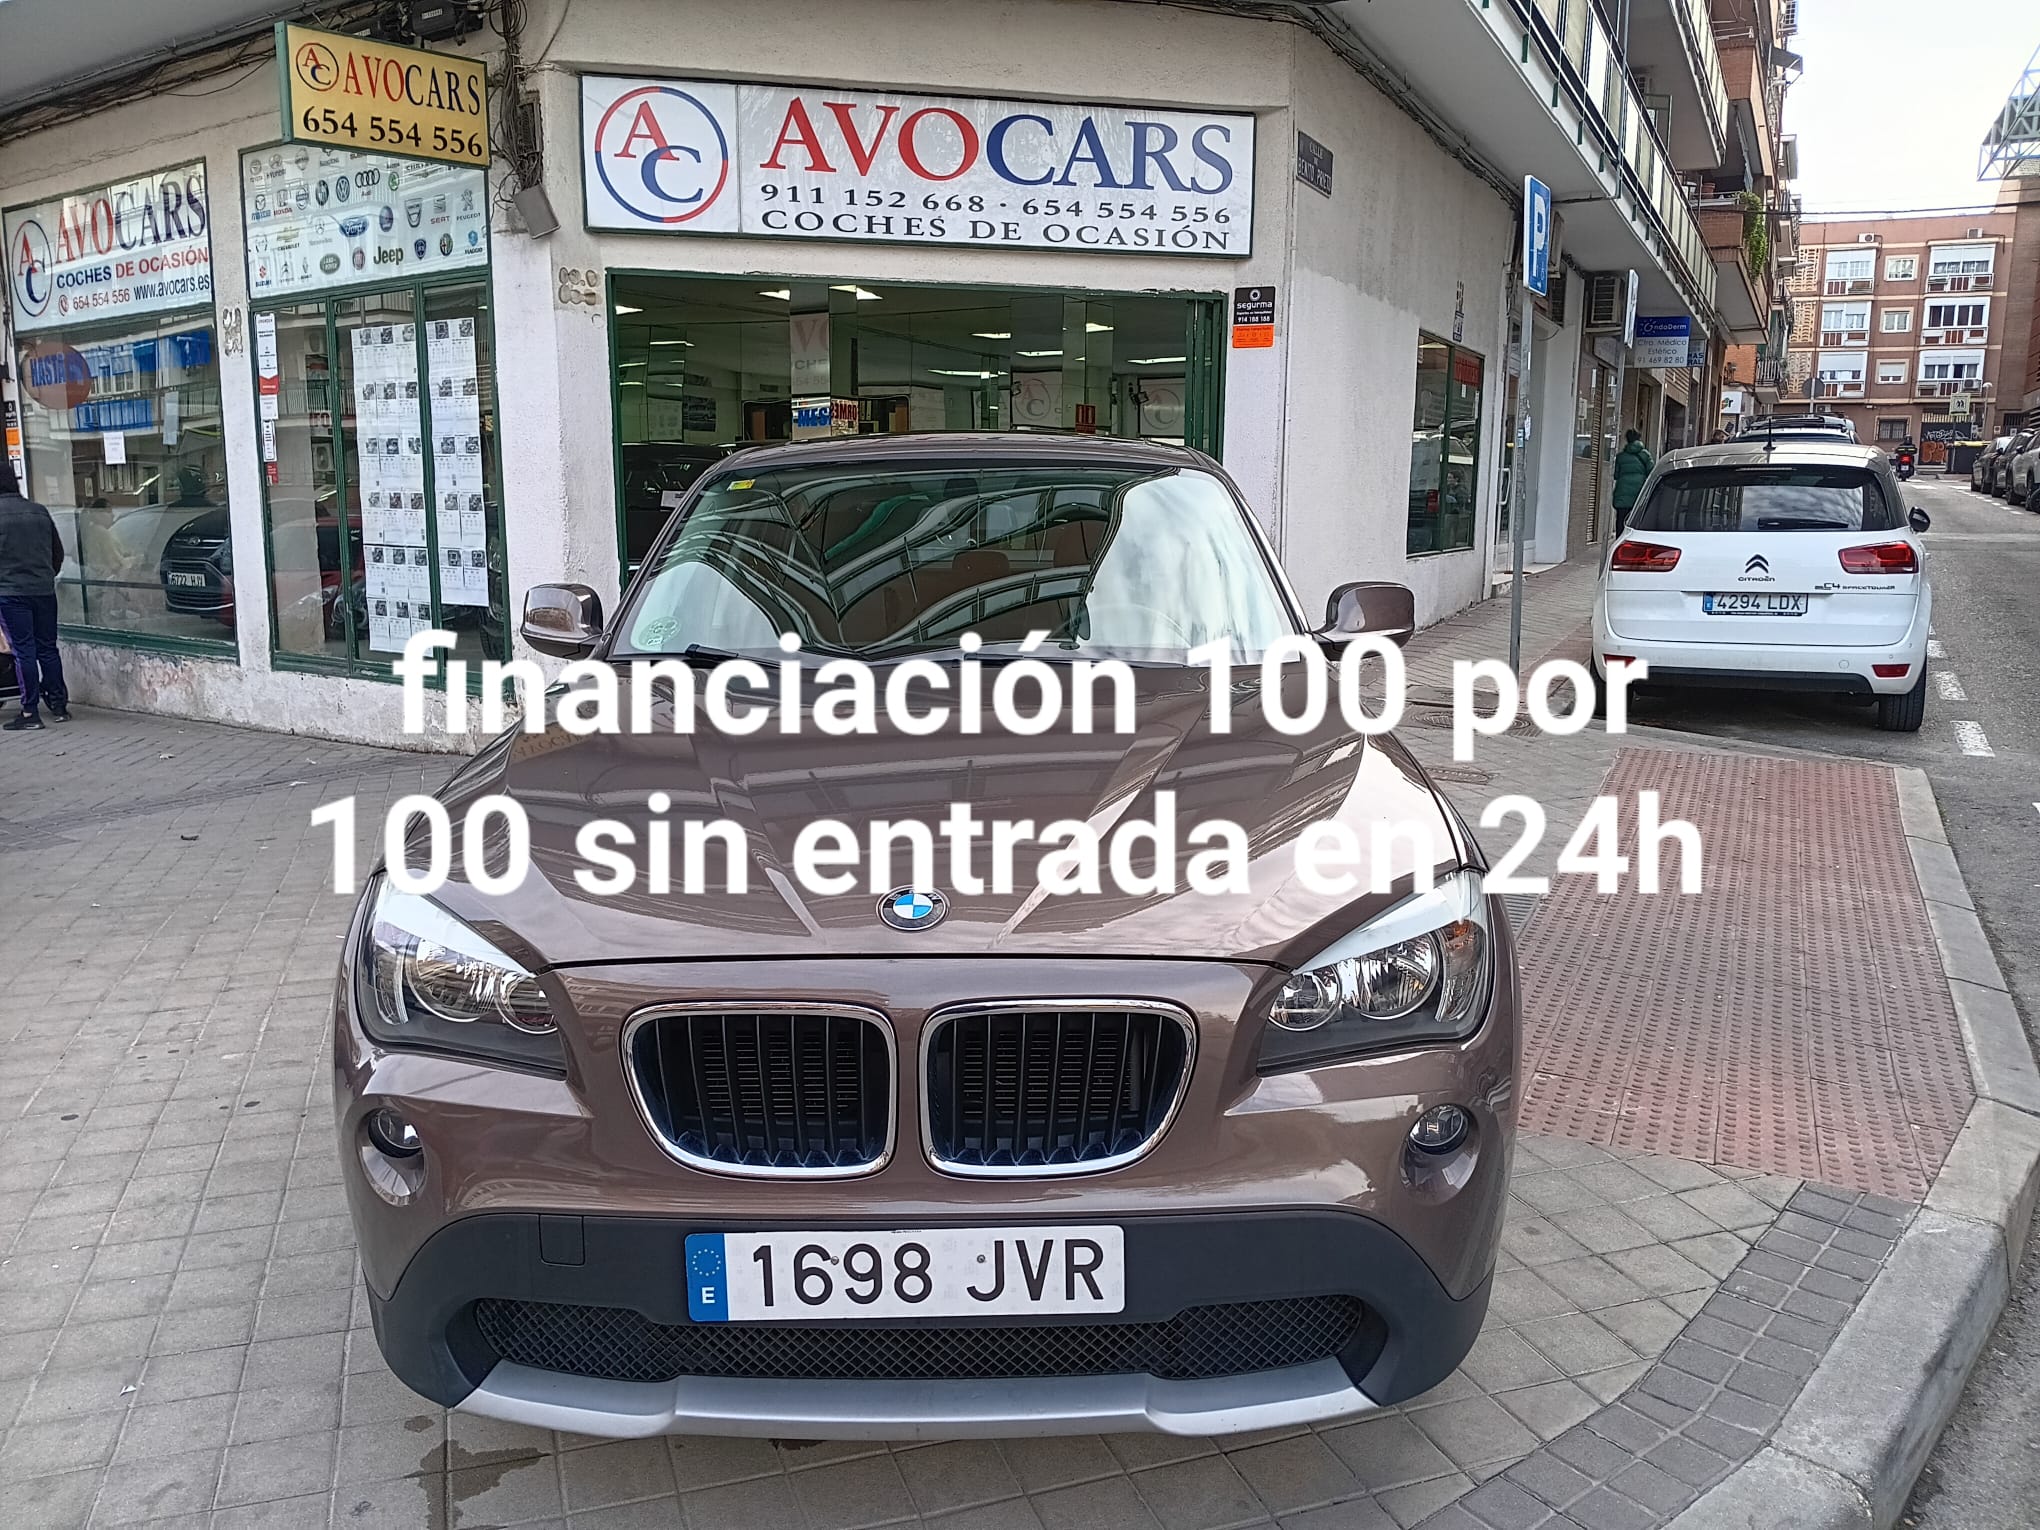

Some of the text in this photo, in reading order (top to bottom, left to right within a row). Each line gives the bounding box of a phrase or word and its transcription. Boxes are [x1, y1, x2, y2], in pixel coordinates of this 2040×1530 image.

[343, 51, 481, 116] AVOCARS
[303, 105, 483, 157] 654 554 556
[759, 96, 1233, 195] AVOCARS
[55, 174, 206, 264] AVOCARS
[430, 215, 450, 225] SEAT
[456, 212, 481, 221] PEUGEOT
[760, 183, 1230, 224] 911 152 668 654 554 556
[761, 210, 1230, 250] COCHES DE OCASIÓN
[1533, 192, 1546, 277] P
[56, 245, 209, 289] COCHES DE OCASIÓN
[373, 245, 404, 266] Jeep
[73, 273, 210, 310] 654 554 556 www.avocars.es
[1236, 301, 1273, 311] segurma
[30, 352, 66, 387] HASTA
[1717, 594, 1761, 610] 4294
[1767, 594, 1801, 611] LDX
[701, 1238, 1104, 1308] E 1698 JVR
